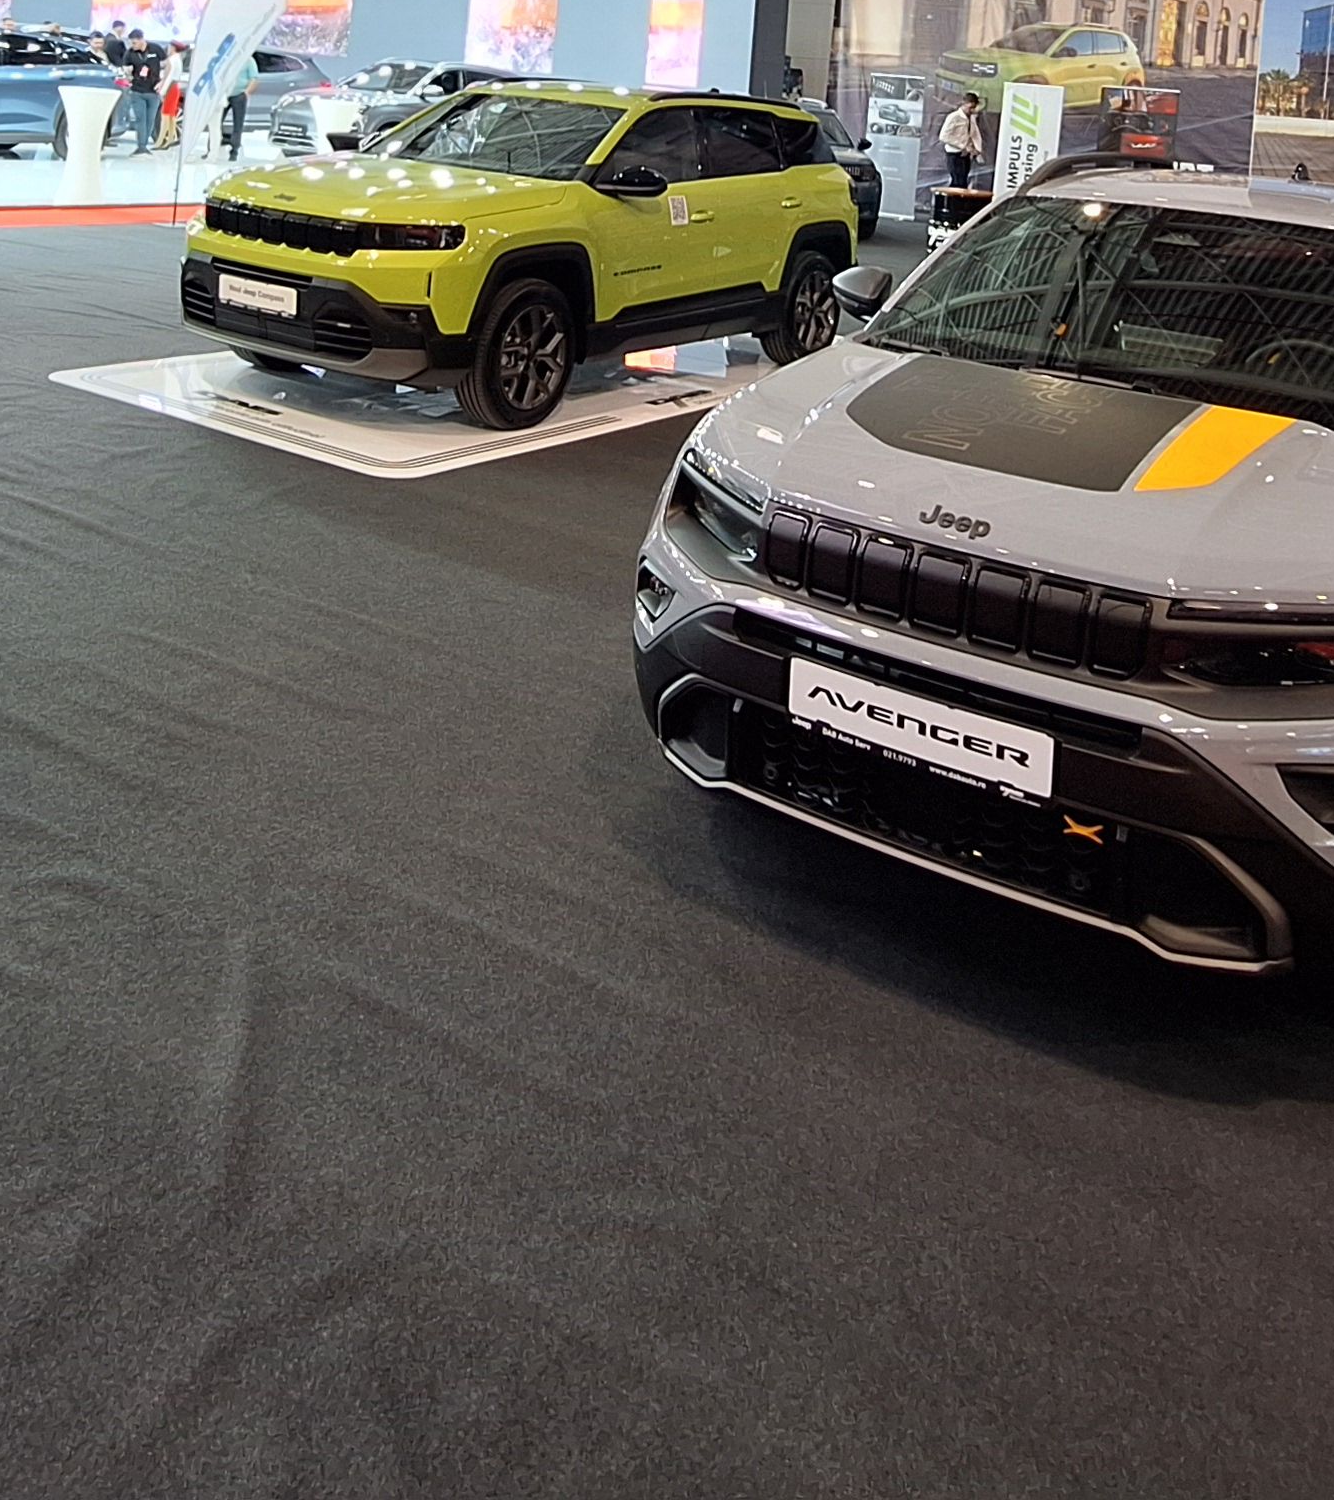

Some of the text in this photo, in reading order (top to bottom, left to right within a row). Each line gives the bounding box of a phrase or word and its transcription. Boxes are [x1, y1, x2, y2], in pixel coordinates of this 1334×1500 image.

[1007, 135, 1024, 189] IMPULS
[919, 505, 991, 539] Jeep
[808, 685, 1030, 768] AVENGER
[822, 727, 836, 740] DAB
[837, 732, 854, 746] Auto
[855, 738, 871, 750] Serv
